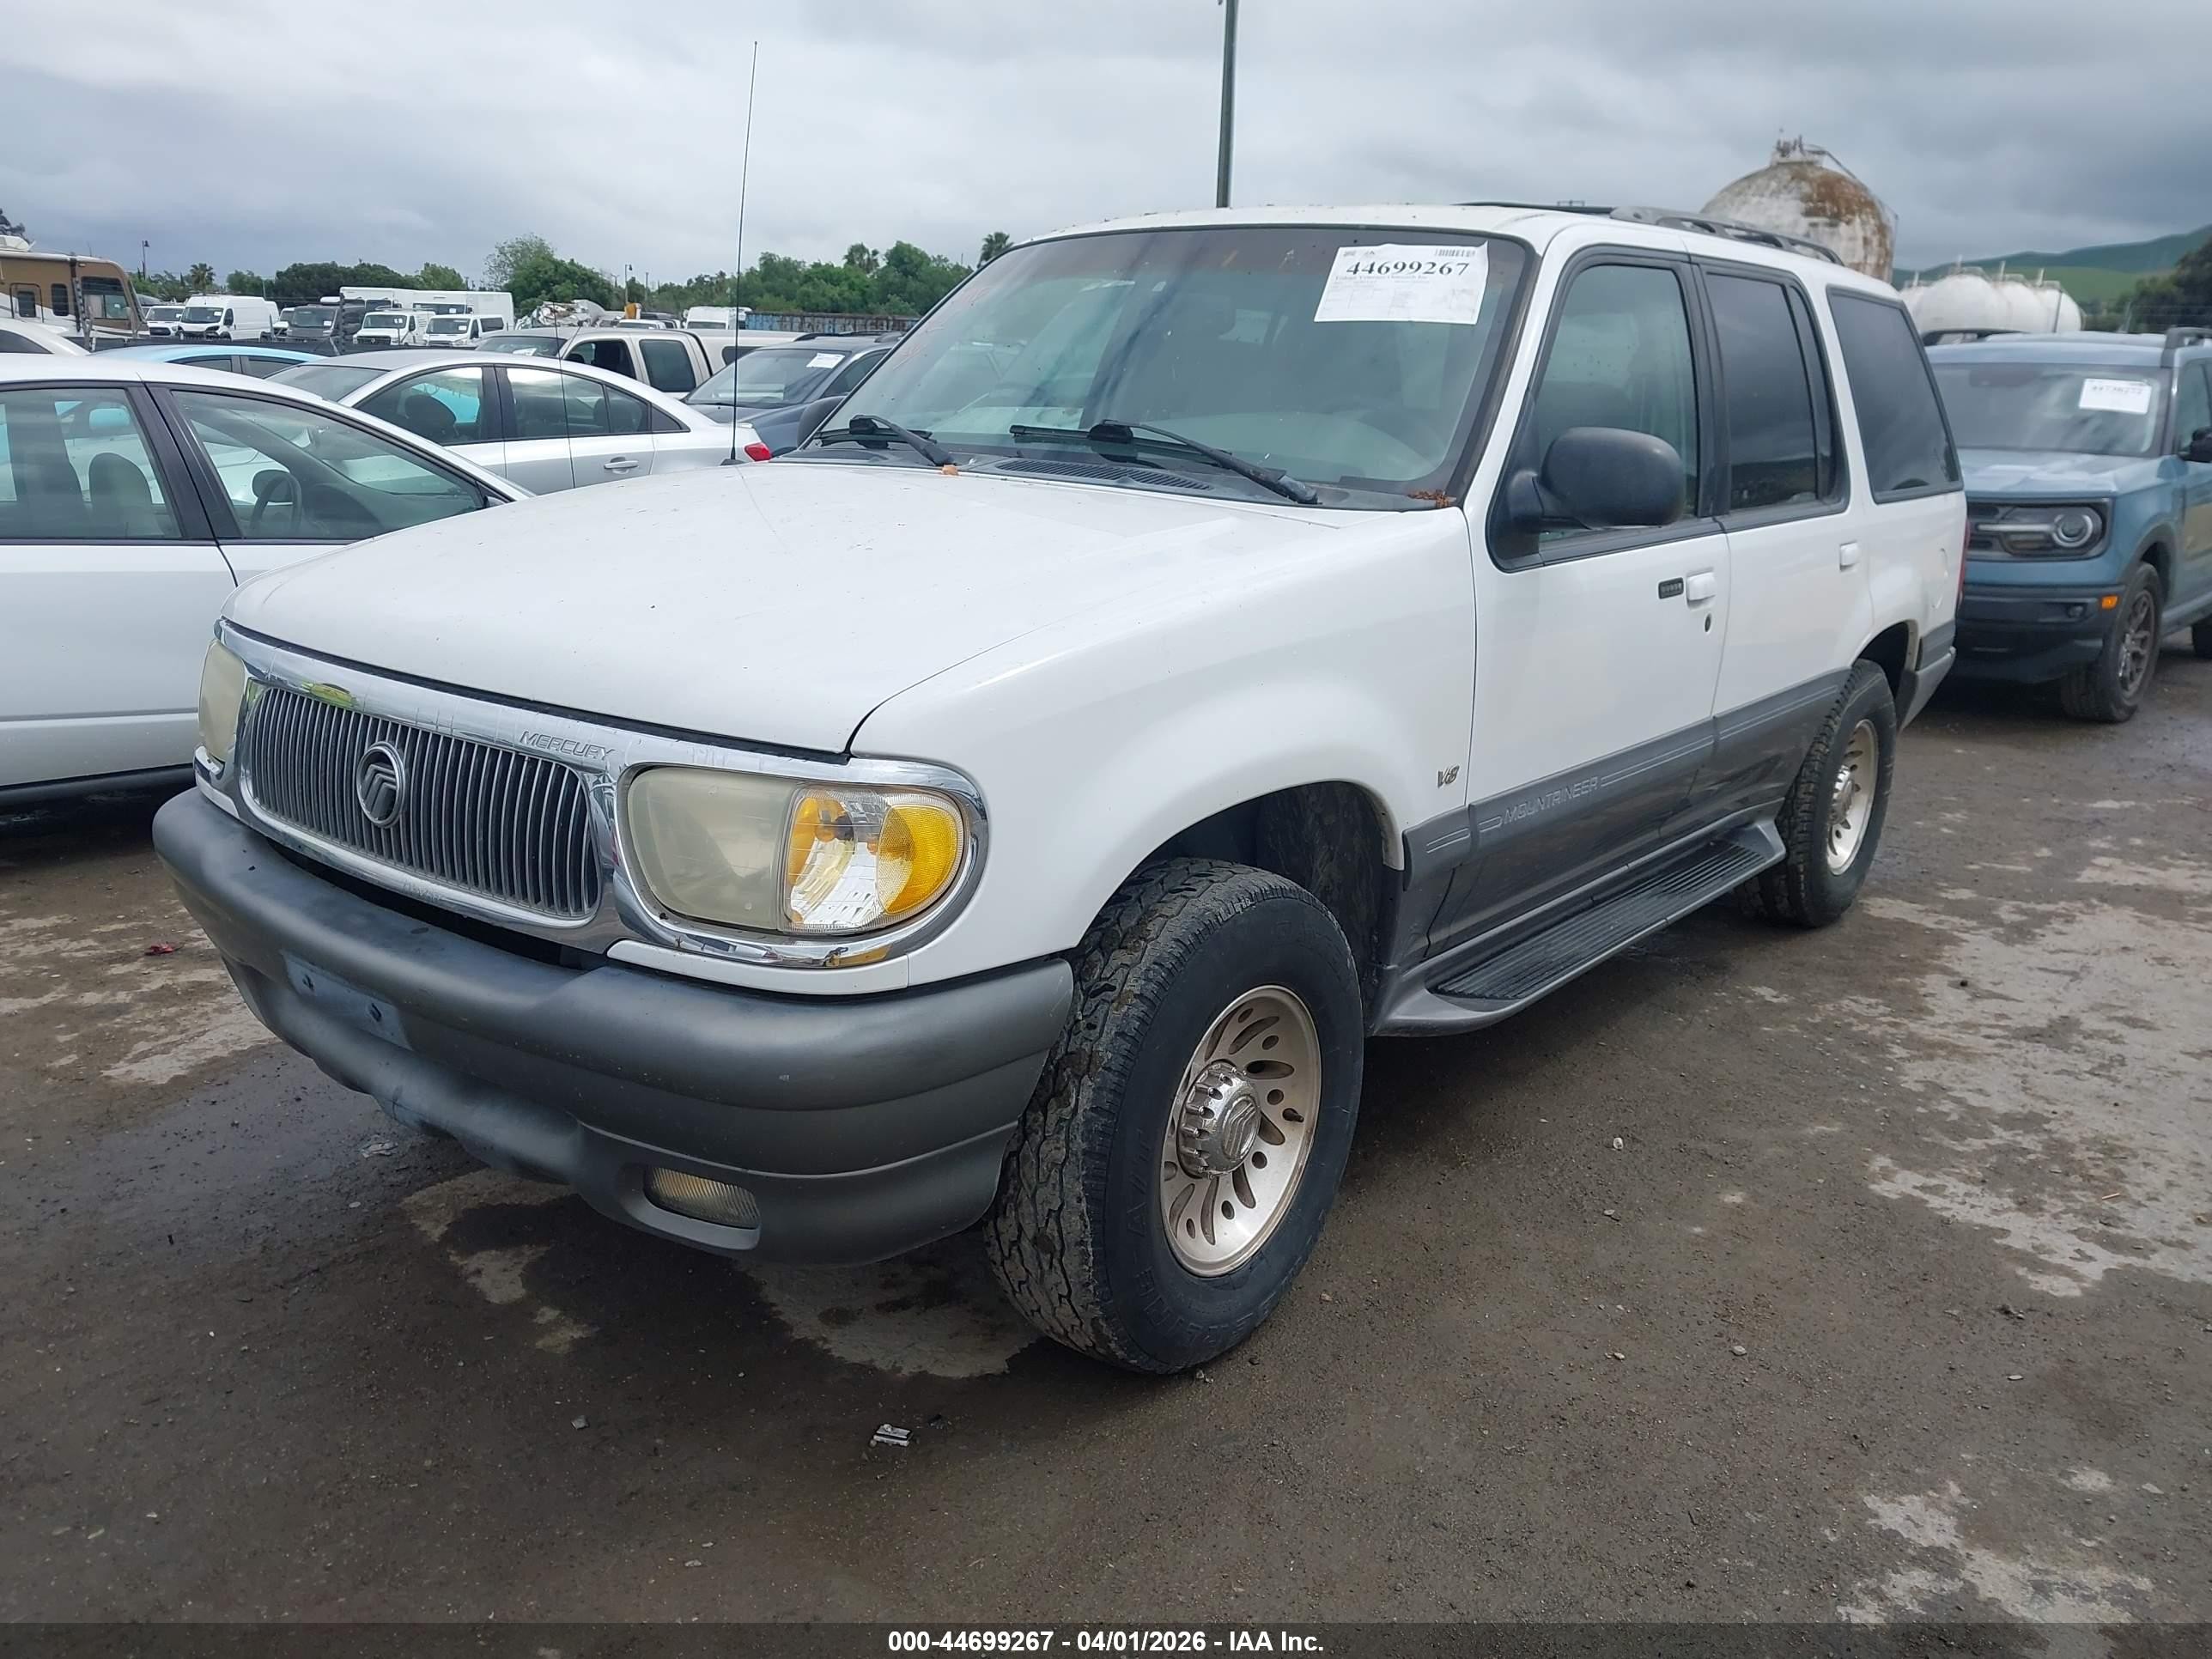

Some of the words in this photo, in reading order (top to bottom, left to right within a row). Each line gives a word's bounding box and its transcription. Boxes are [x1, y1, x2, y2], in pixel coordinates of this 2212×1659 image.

[1346, 261, 1469, 276] 44699267
[520, 731, 616, 760] MERCURY
[1504, 776, 1598, 823] MOUNTAINEER
